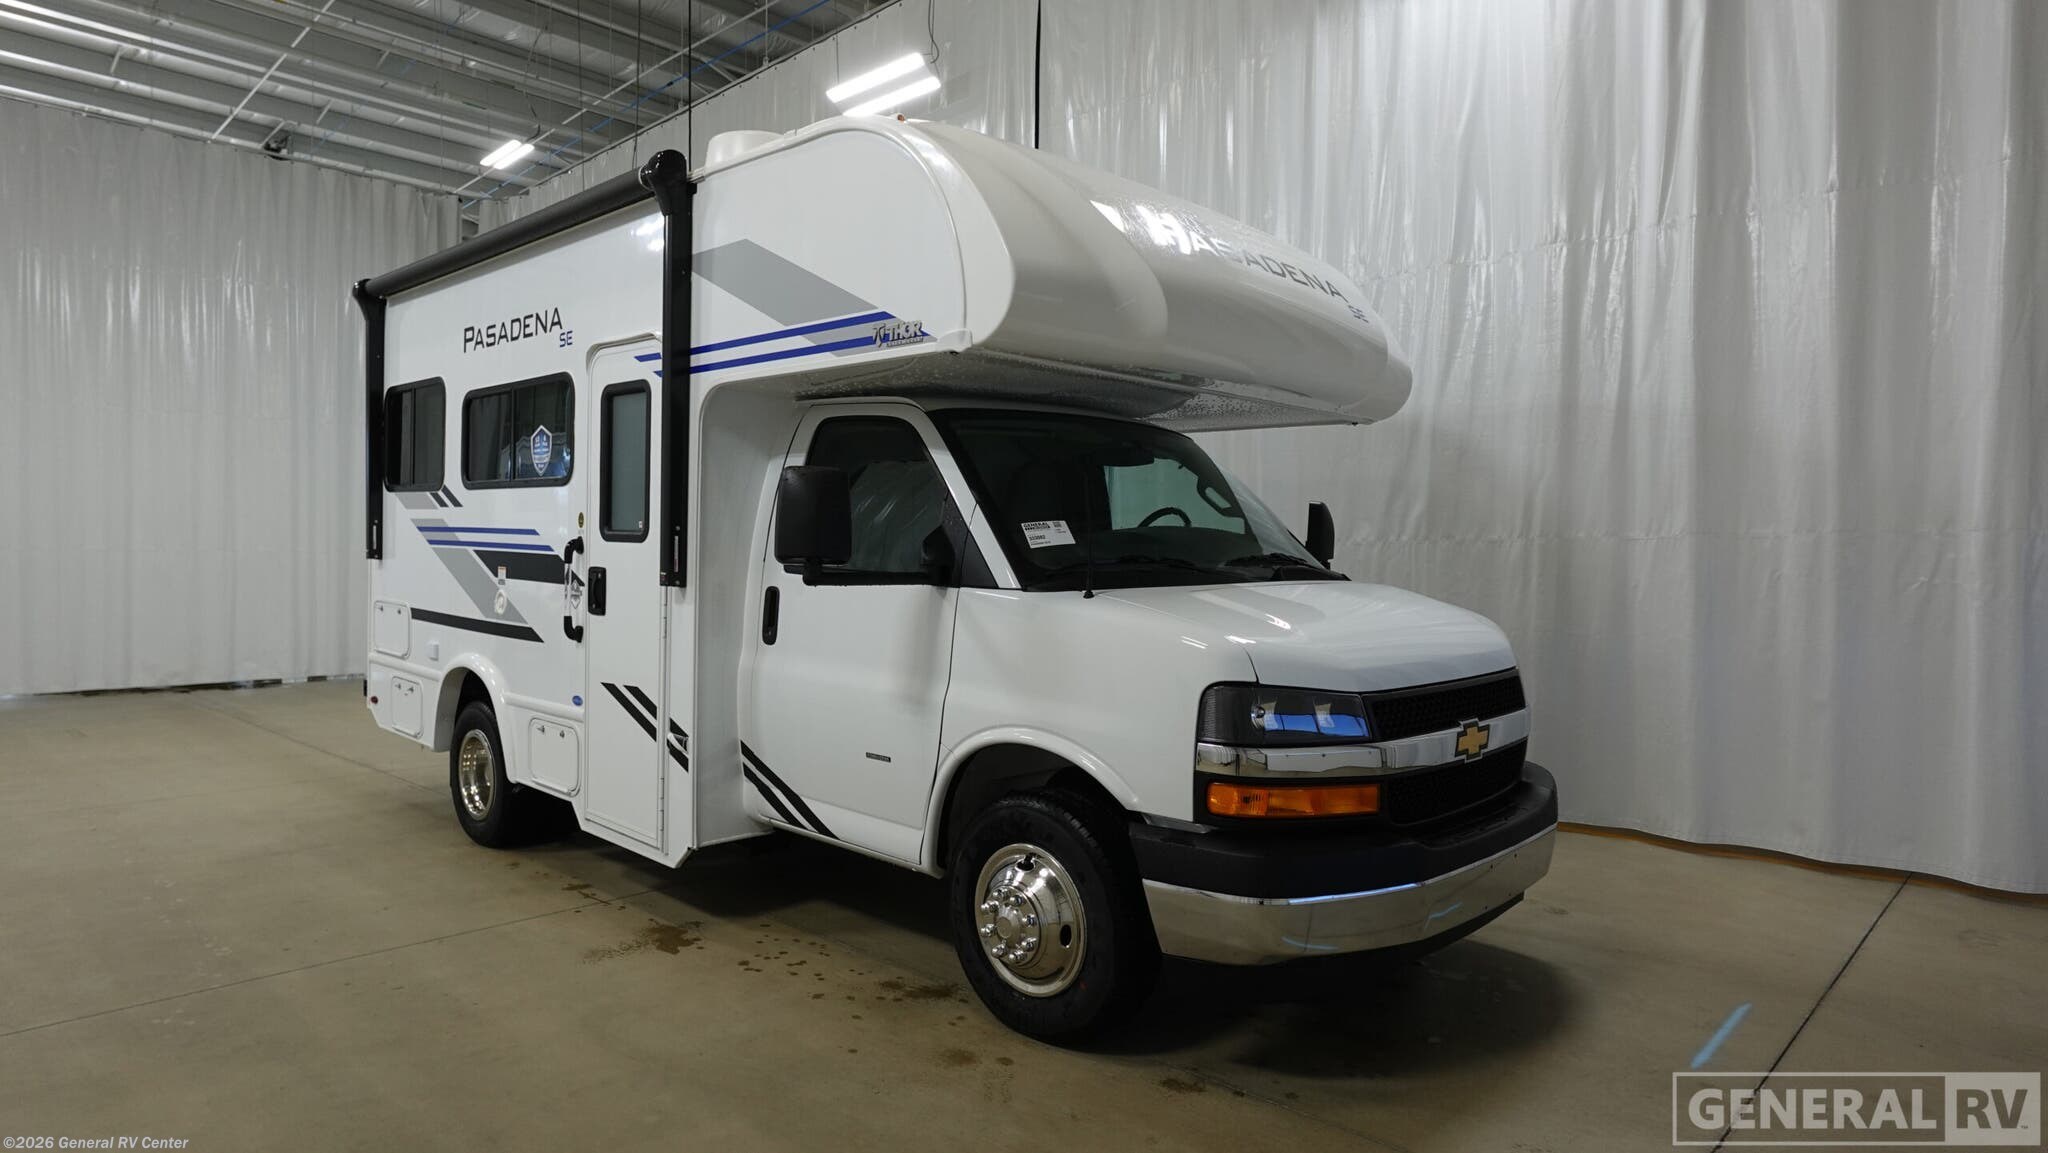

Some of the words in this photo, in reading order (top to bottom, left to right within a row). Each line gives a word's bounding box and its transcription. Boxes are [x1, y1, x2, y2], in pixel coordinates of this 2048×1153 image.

[463, 307, 563, 354] PASADENA
[559, 330, 573, 348] SE
[885, 319, 923, 342] THOR
